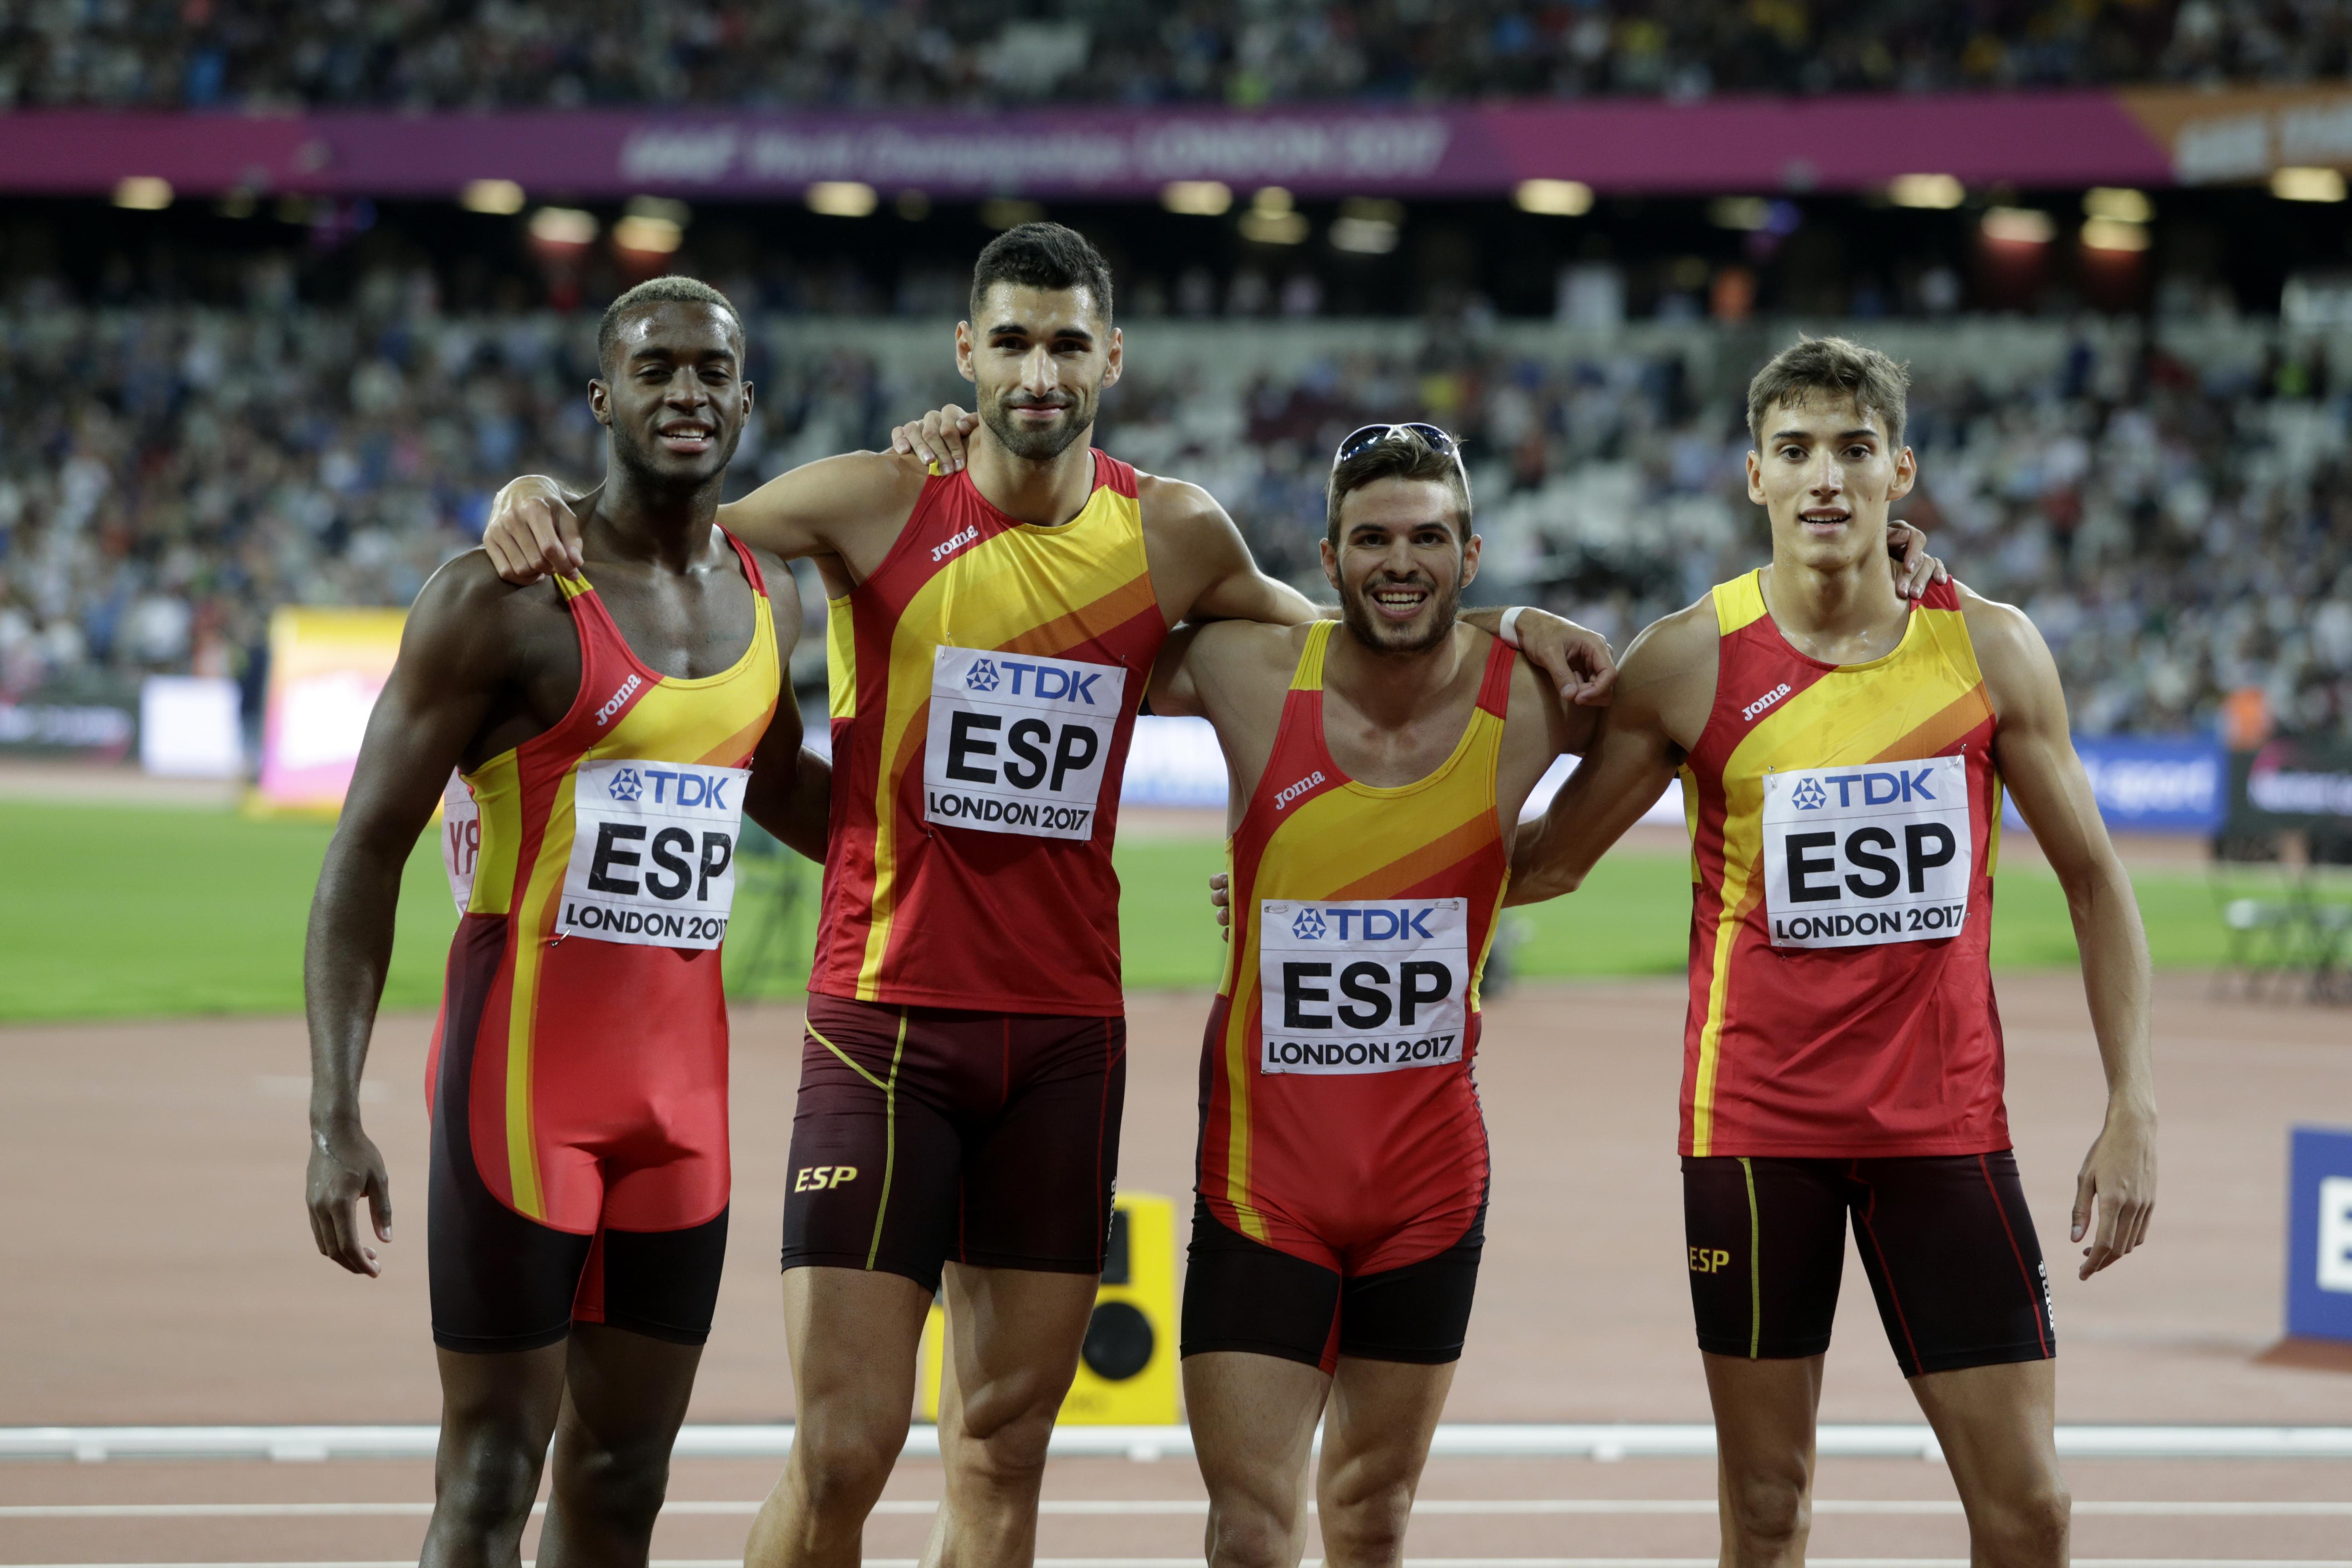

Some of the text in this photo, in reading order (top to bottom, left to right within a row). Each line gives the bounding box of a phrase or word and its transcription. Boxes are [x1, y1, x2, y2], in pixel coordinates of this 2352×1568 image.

[932, 524, 979, 562] Joma
[595, 674, 641, 726] Joma
[1001, 661, 1102, 705] TDK
[1742, 681, 1791, 721] Joma
[946, 710, 1098, 791] ESP
[645, 769, 729, 809] TDK
[1275, 770, 1325, 810] Joma
[1825, 768, 1936, 807] TDK
[930, 792, 1089, 830] LONDON 2017
[588, 822, 732, 901] ESP
[1785, 822, 1955, 903] ESP
[566, 903, 685, 938] LONDON
[1326, 908, 1435, 940] TDK
[1776, 904, 1964, 940] LONDON 2017
[1283, 960, 1452, 1029] ESP
[1269, 1034, 1455, 1065] LONDON 2017
[794, 1165, 858, 1193] ESP
[1689, 1246, 1730, 1274] ESP
